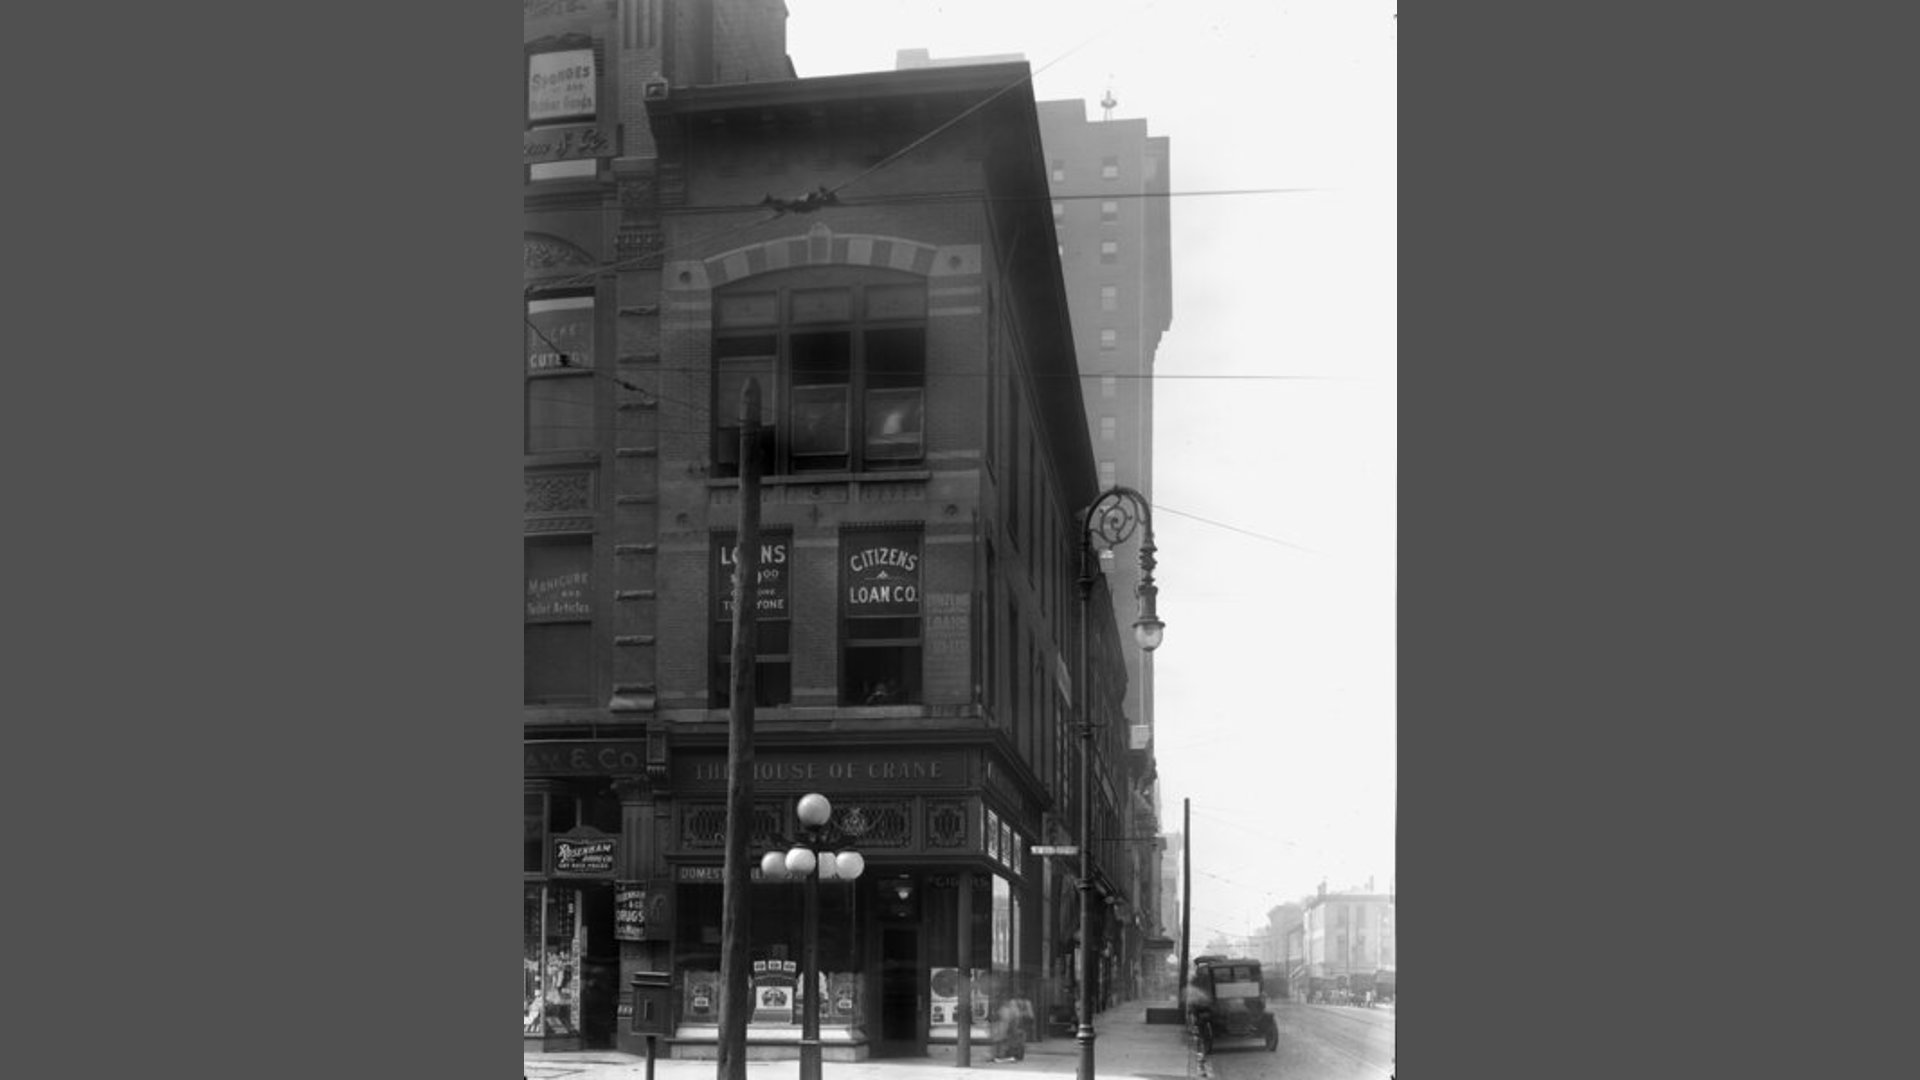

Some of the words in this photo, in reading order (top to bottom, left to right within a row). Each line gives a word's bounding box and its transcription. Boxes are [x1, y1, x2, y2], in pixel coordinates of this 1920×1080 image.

[721, 545, 786, 565] LNS
[850, 547, 918, 571] CITIZENS
[849, 585, 890, 604] LOAN
[828, 761, 856, 779] OF
[868, 761, 943, 779] CRANE
